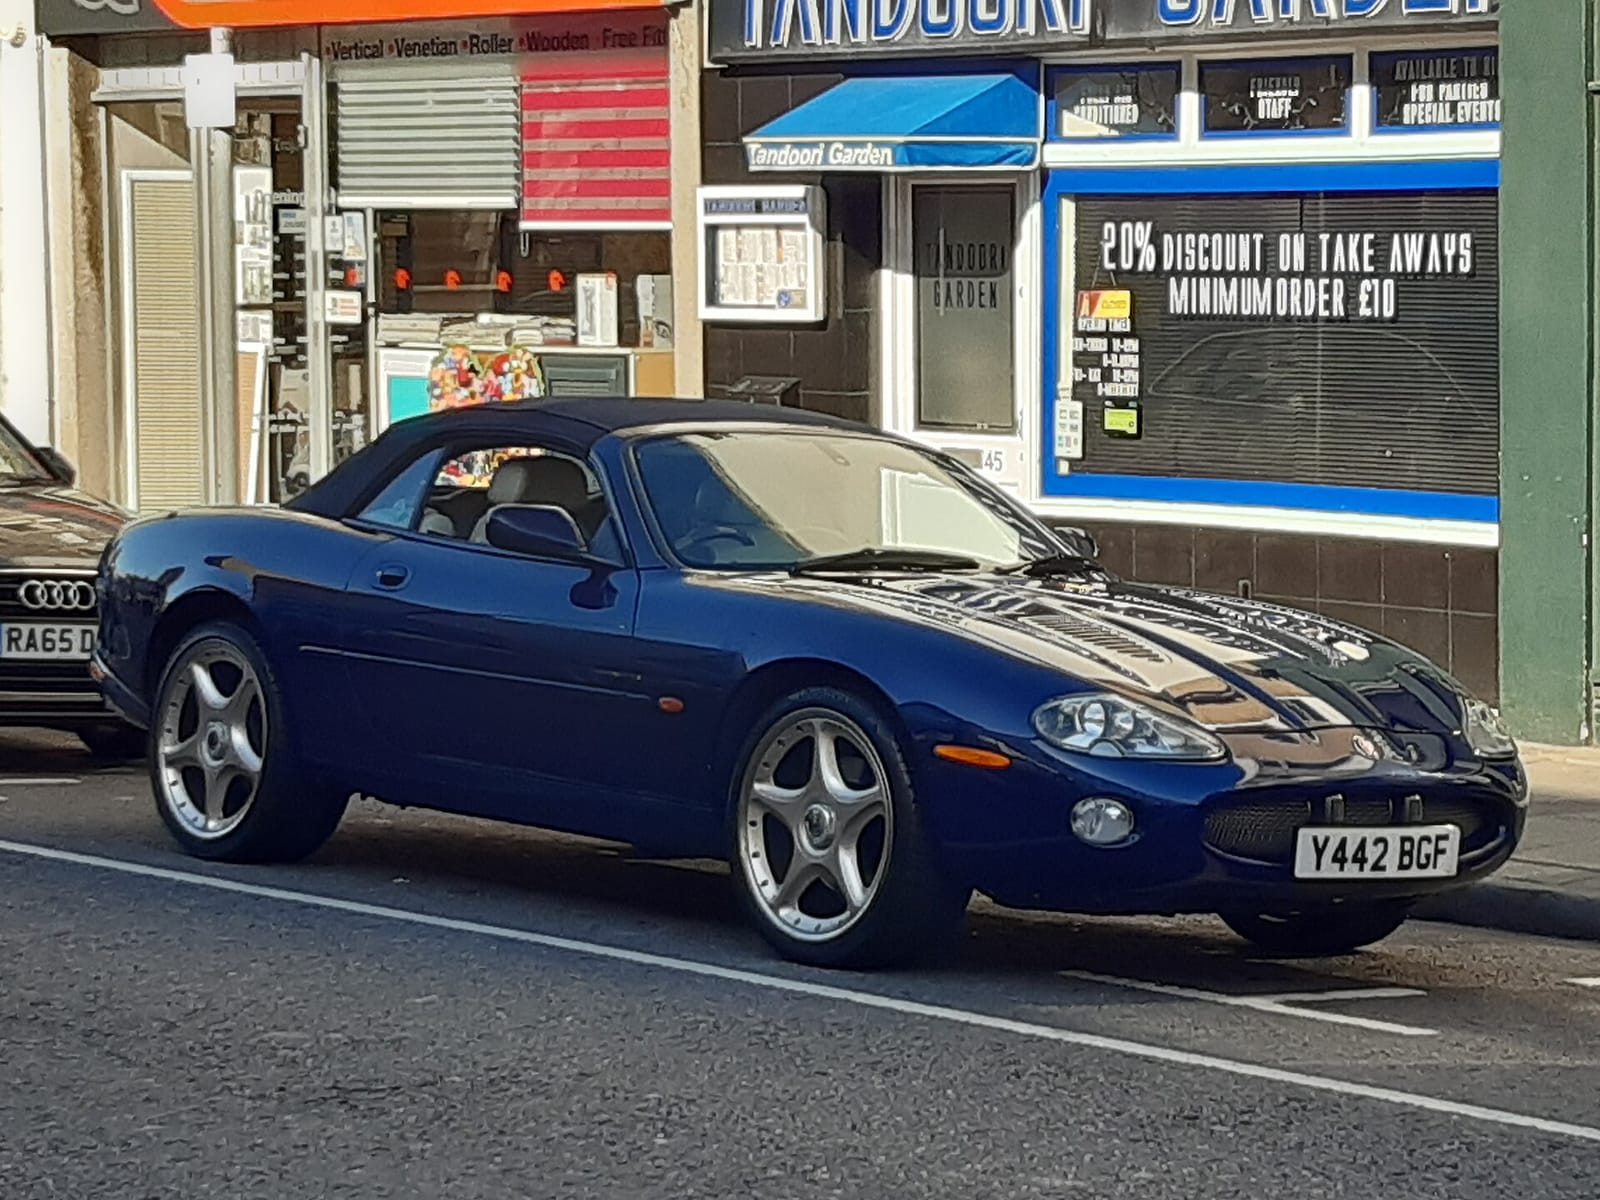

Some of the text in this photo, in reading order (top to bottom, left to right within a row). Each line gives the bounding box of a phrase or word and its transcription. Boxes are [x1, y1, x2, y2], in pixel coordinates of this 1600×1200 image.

[331, 39, 384, 60] Vertical
[394, 36, 458, 57] Venetian
[469, 34, 514, 55] Roller
[526, 31, 589, 51] Wooden
[602, 27, 637, 48] Free
[1394, 58, 1457, 81] AVAILABLE
[1403, 102, 1452, 125] SPECIAL
[748, 142, 893, 165] Tandoori Garden
[1102, 221, 1471, 273] 20% DISCOUNT ON TAKE AWAYS
[933, 280, 997, 309] GARDEN
[1169, 277, 1395, 318] MINIMUM ORDER £10
[984, 450, 1003, 471] 45
[7, 627, 73, 653] RA65
[1312, 834, 1450, 872] Y442 BGF
